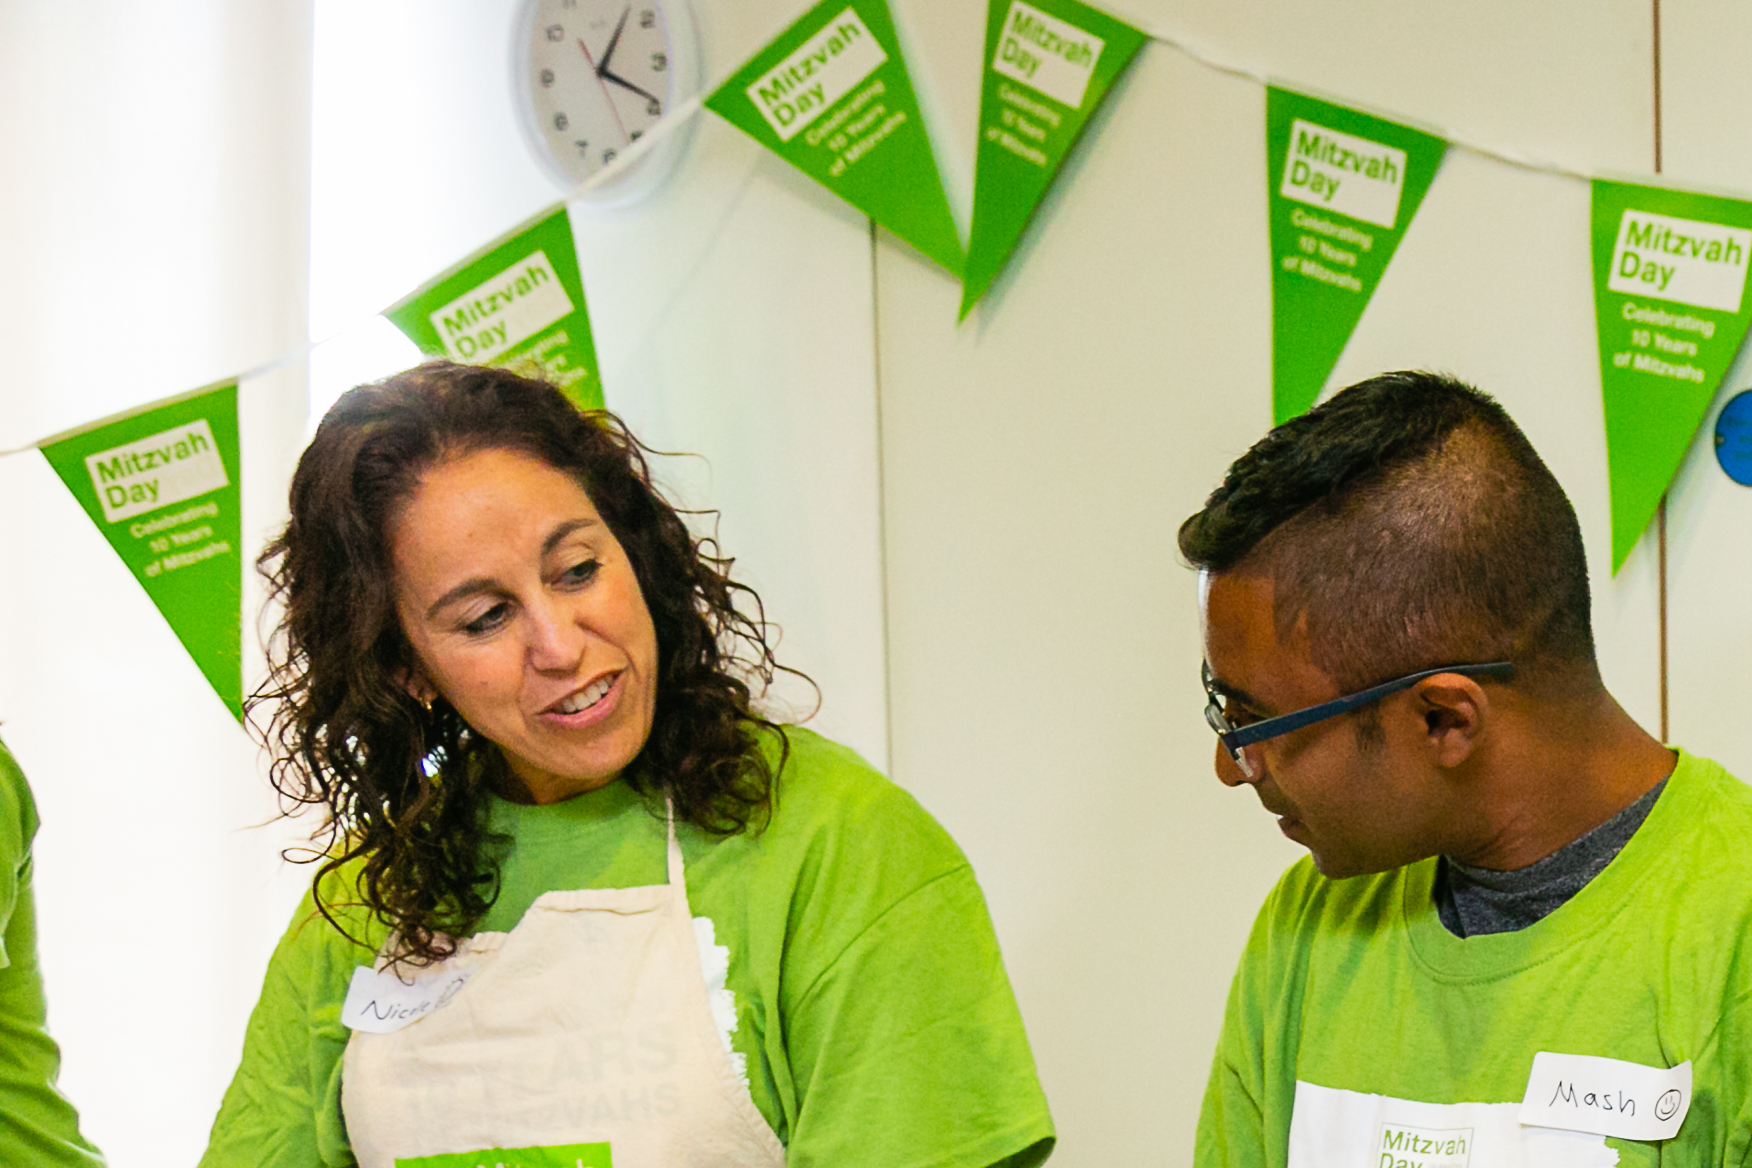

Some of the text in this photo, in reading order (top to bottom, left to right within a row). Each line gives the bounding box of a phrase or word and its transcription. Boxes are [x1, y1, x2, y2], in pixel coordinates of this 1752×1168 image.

[1002, 37, 1042, 79] Day
[1011, 11, 1093, 68] Mitzvah
[758, 23, 861, 106] Mitzvah
[772, 83, 825, 127] Day
[1297, 130, 1397, 184] Mitzvah
[1290, 160, 1340, 202] Day
[1625, 220, 1741, 266] Mitzvah
[1619, 251, 1674, 291] Day
[443, 265, 549, 336] Mitzvah
[1623, 302, 1715, 339] Celebrating
[455, 320, 507, 358] Day
[1632, 330, 1697, 357] 10 Years
[1614, 353, 1704, 383] of Mitzvahs
[97, 431, 209, 484] Mitzvah
[106, 477, 160, 509] Day
[1549, 1081, 1635, 1117] Mash
[1383, 1130, 1466, 1156] Mitzvah
